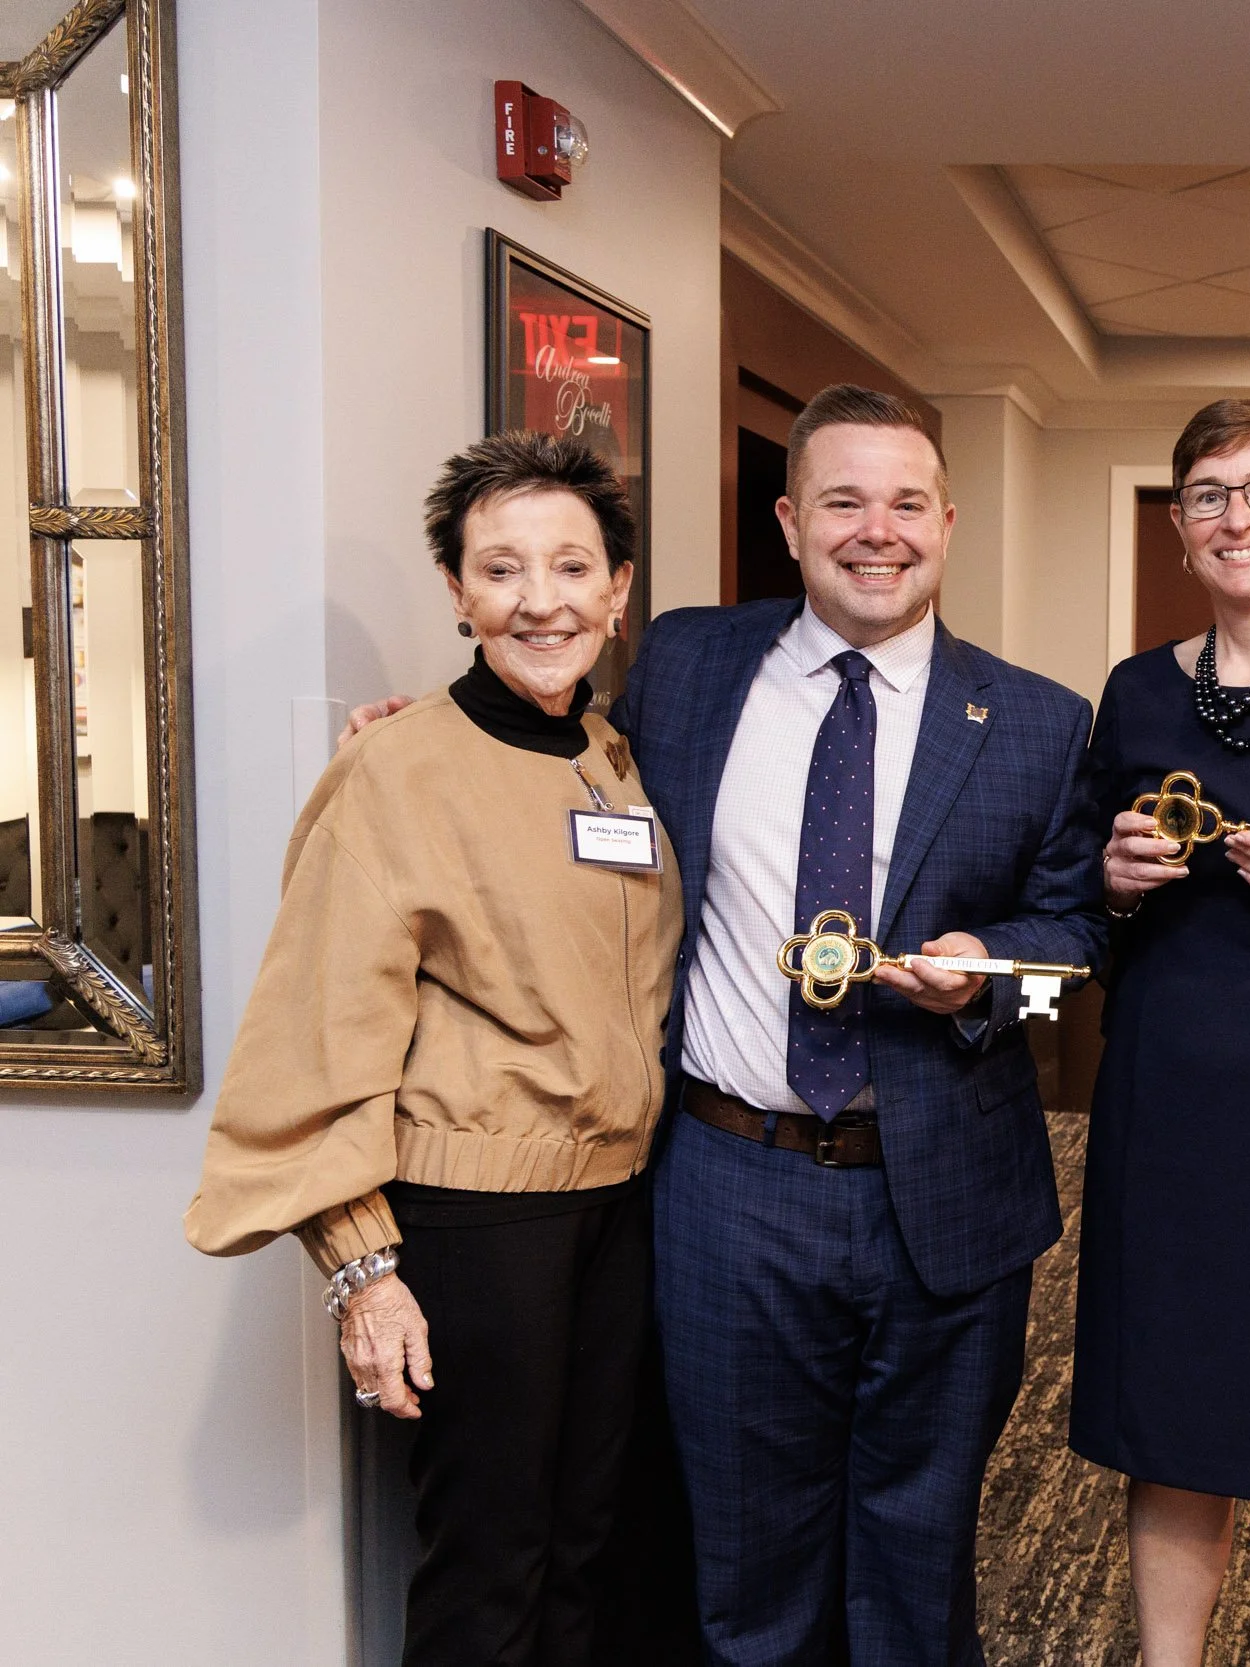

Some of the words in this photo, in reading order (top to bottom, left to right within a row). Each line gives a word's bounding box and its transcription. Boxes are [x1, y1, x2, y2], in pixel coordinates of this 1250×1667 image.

[505, 103, 515, 155] FIRE
[535, 344, 590, 388] Andrea
[555, 381, 612, 436] Bocelli
[587, 826, 611, 835] Ashby
[941, 958, 954, 966] TO
[957, 959, 972, 968] THE
[977, 961, 1000, 969] CITY
